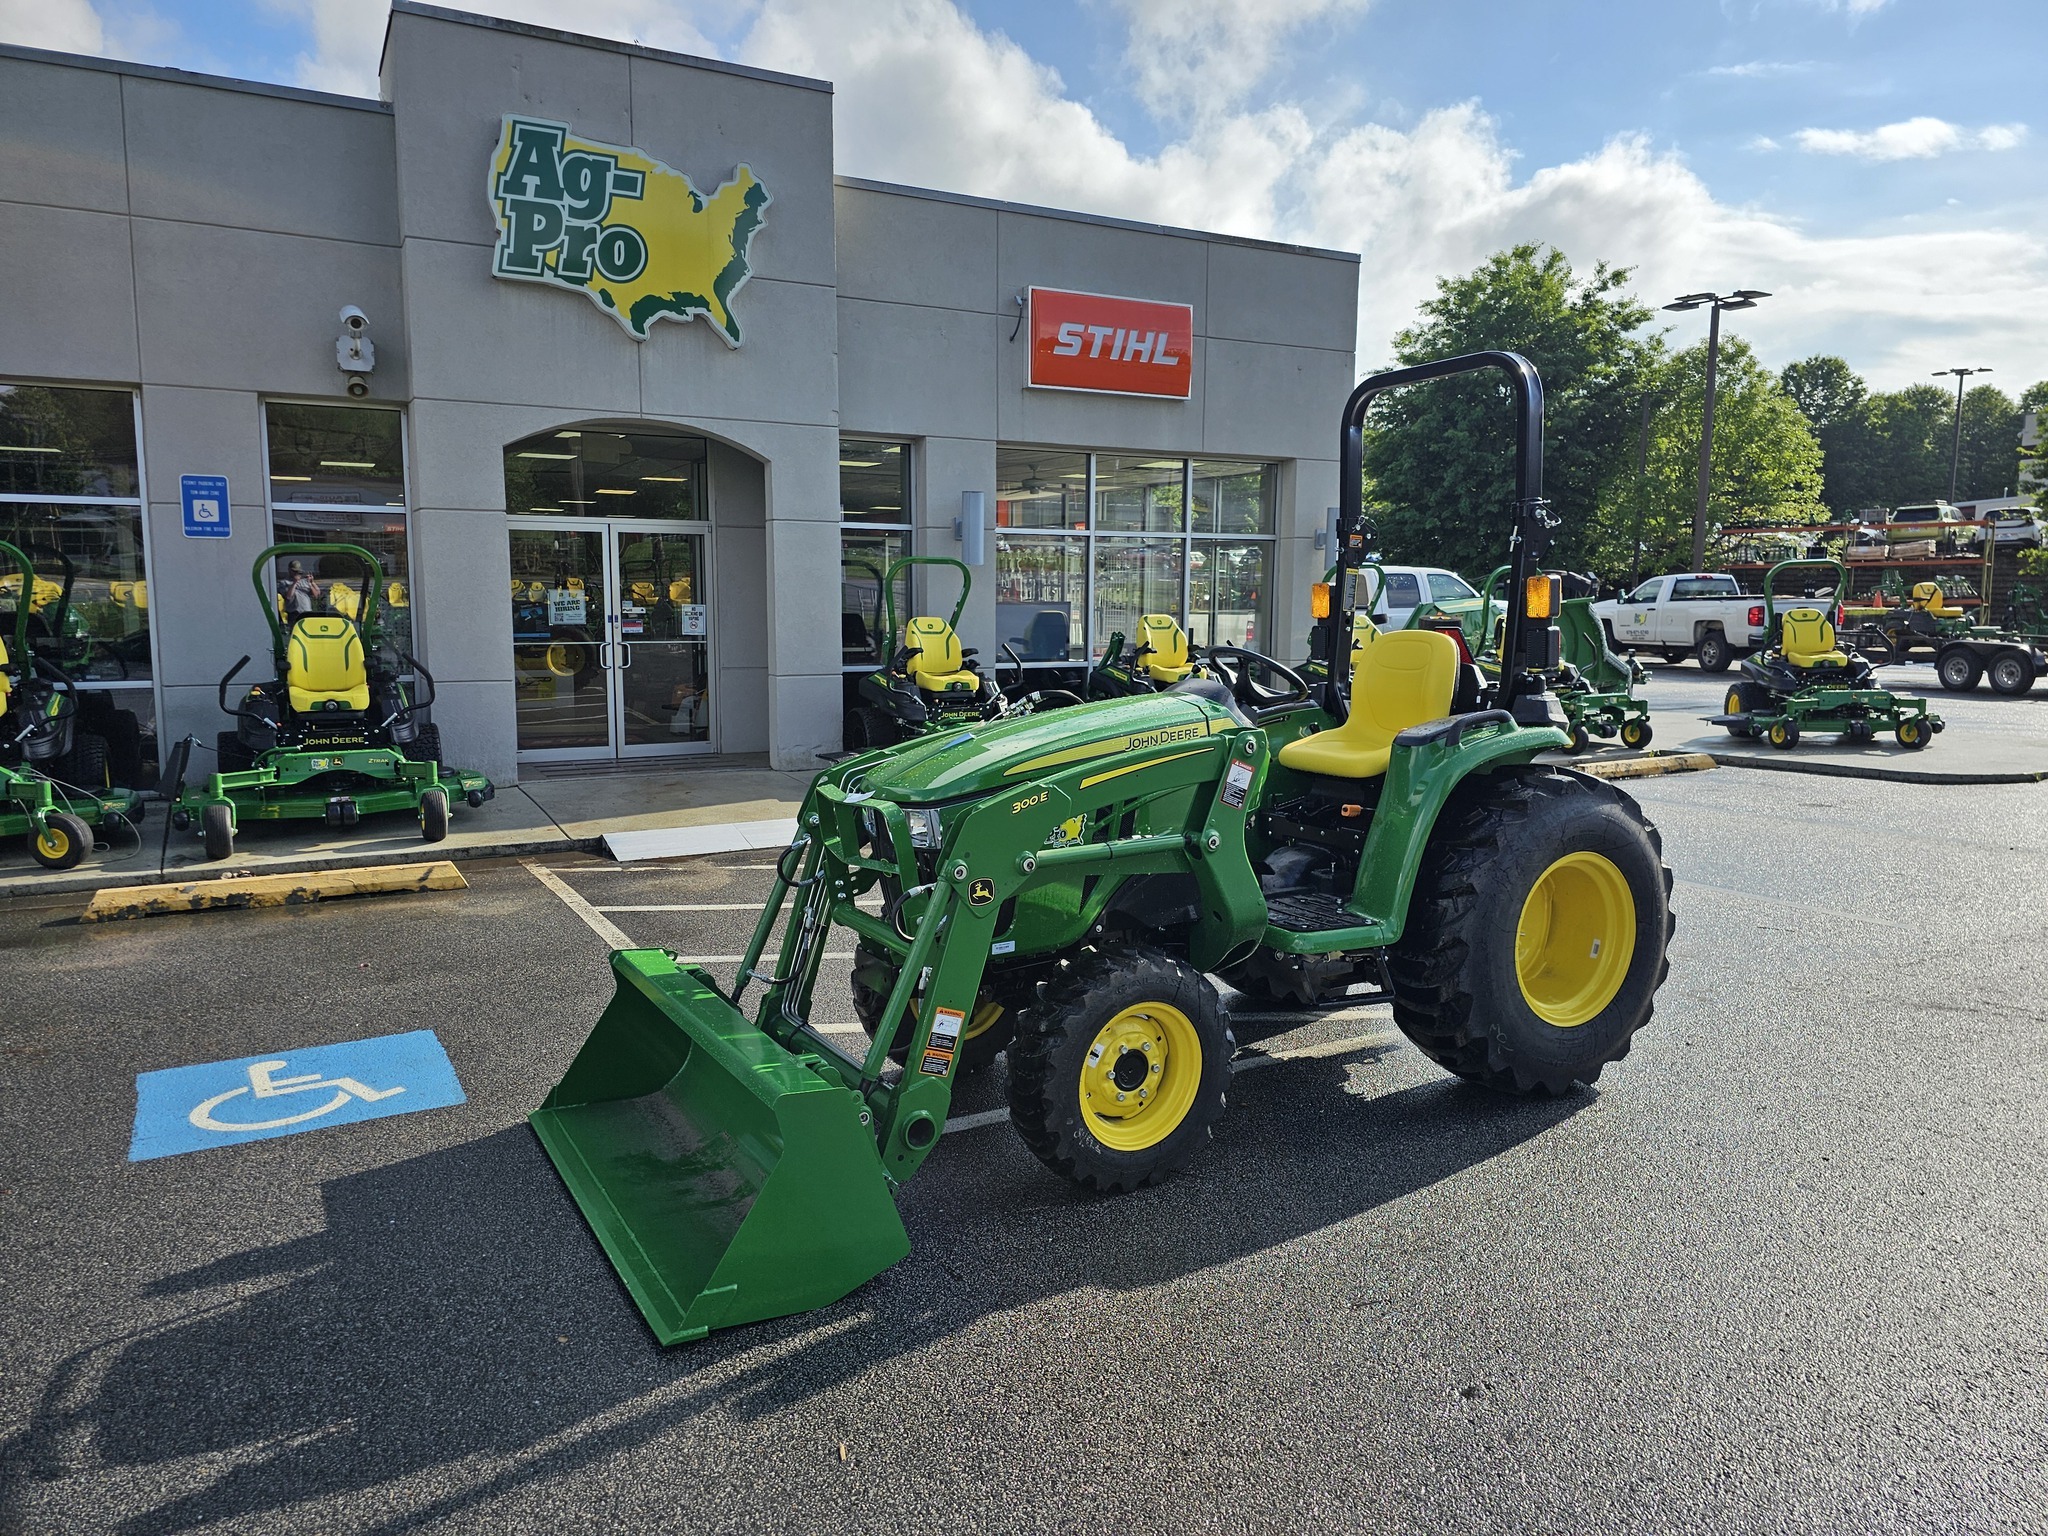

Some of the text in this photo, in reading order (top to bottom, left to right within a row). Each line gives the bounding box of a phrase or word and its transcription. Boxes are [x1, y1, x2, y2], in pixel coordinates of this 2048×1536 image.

[496, 120, 646, 223] Ag-
[498, 200, 648, 284] Pro
[1053, 322, 1179, 366] STIHL
[1125, 727, 1199, 751] JOHN DEERE
